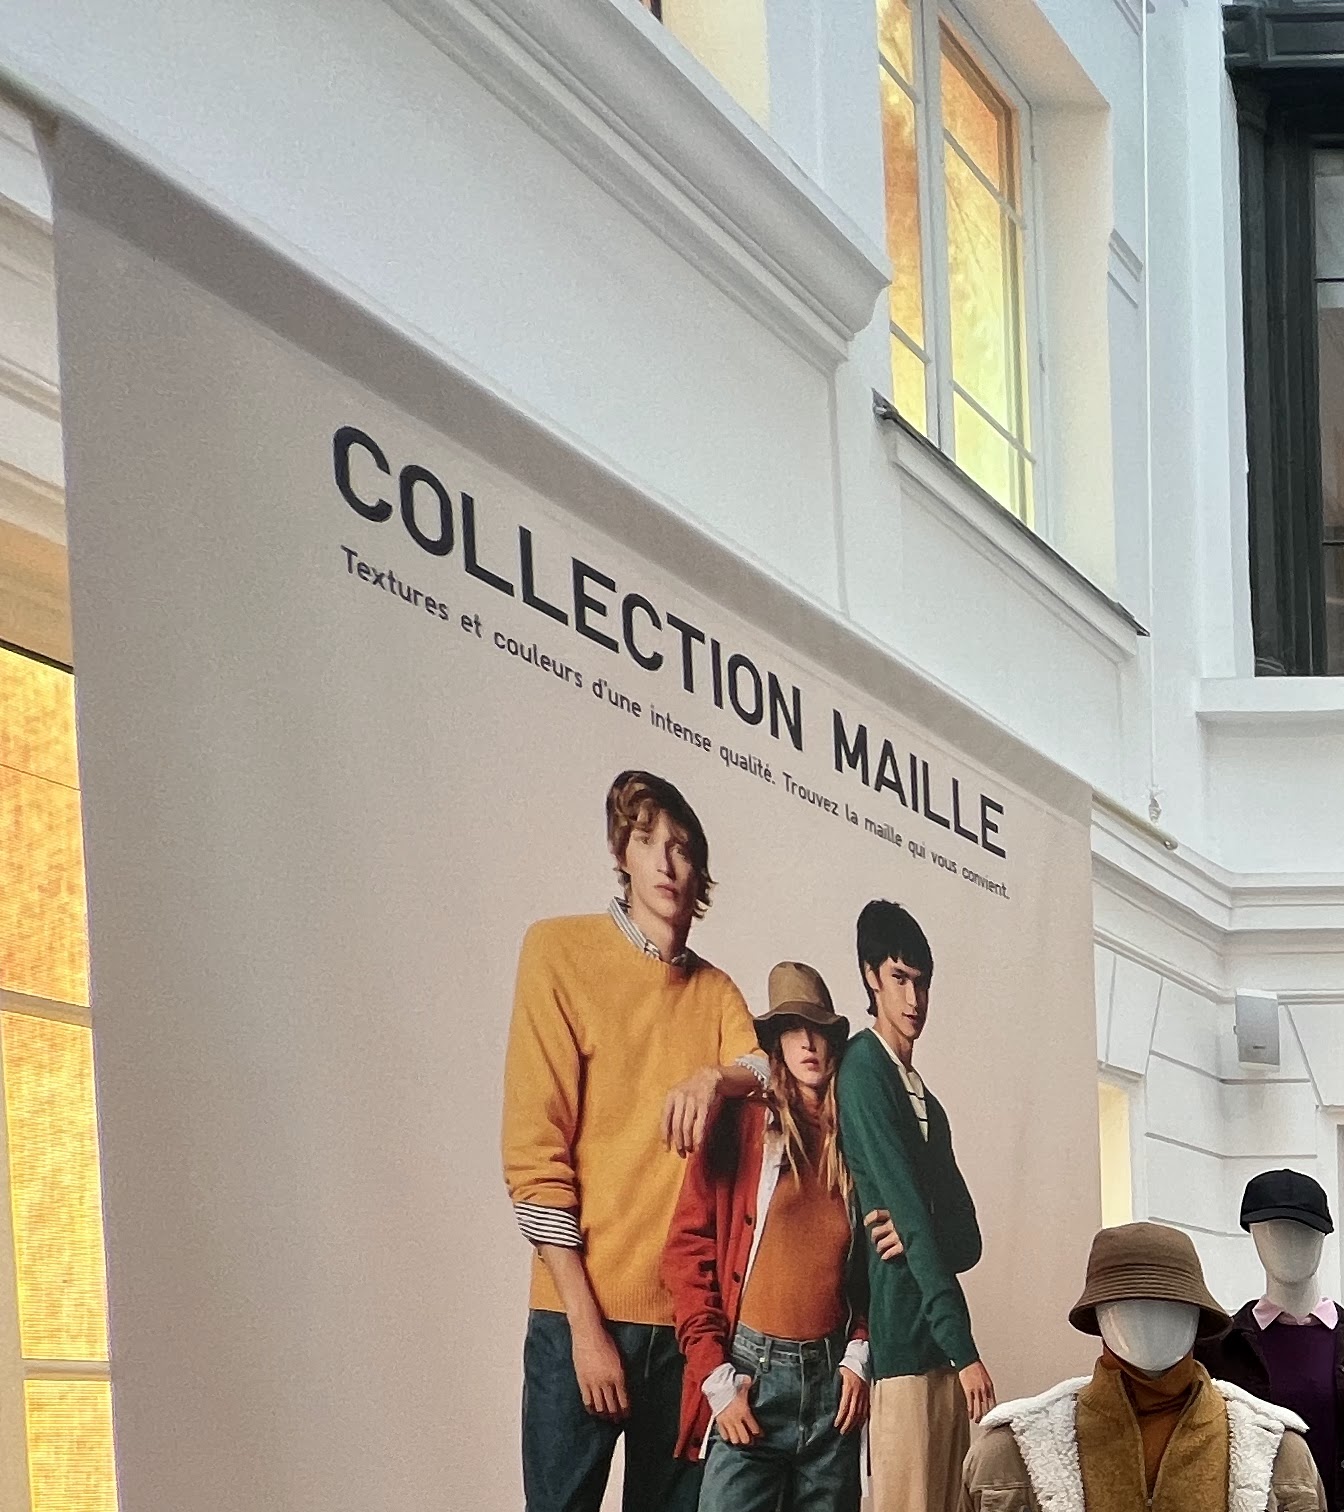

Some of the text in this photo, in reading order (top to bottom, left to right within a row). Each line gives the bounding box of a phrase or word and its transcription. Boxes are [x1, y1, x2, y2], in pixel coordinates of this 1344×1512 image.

[333, 426, 1007, 859] COLLECTION MAILLE
[340, 546, 1011, 900] Textures et couleurs d'une intense qualité. Trouvez la maille qui vous convient.
